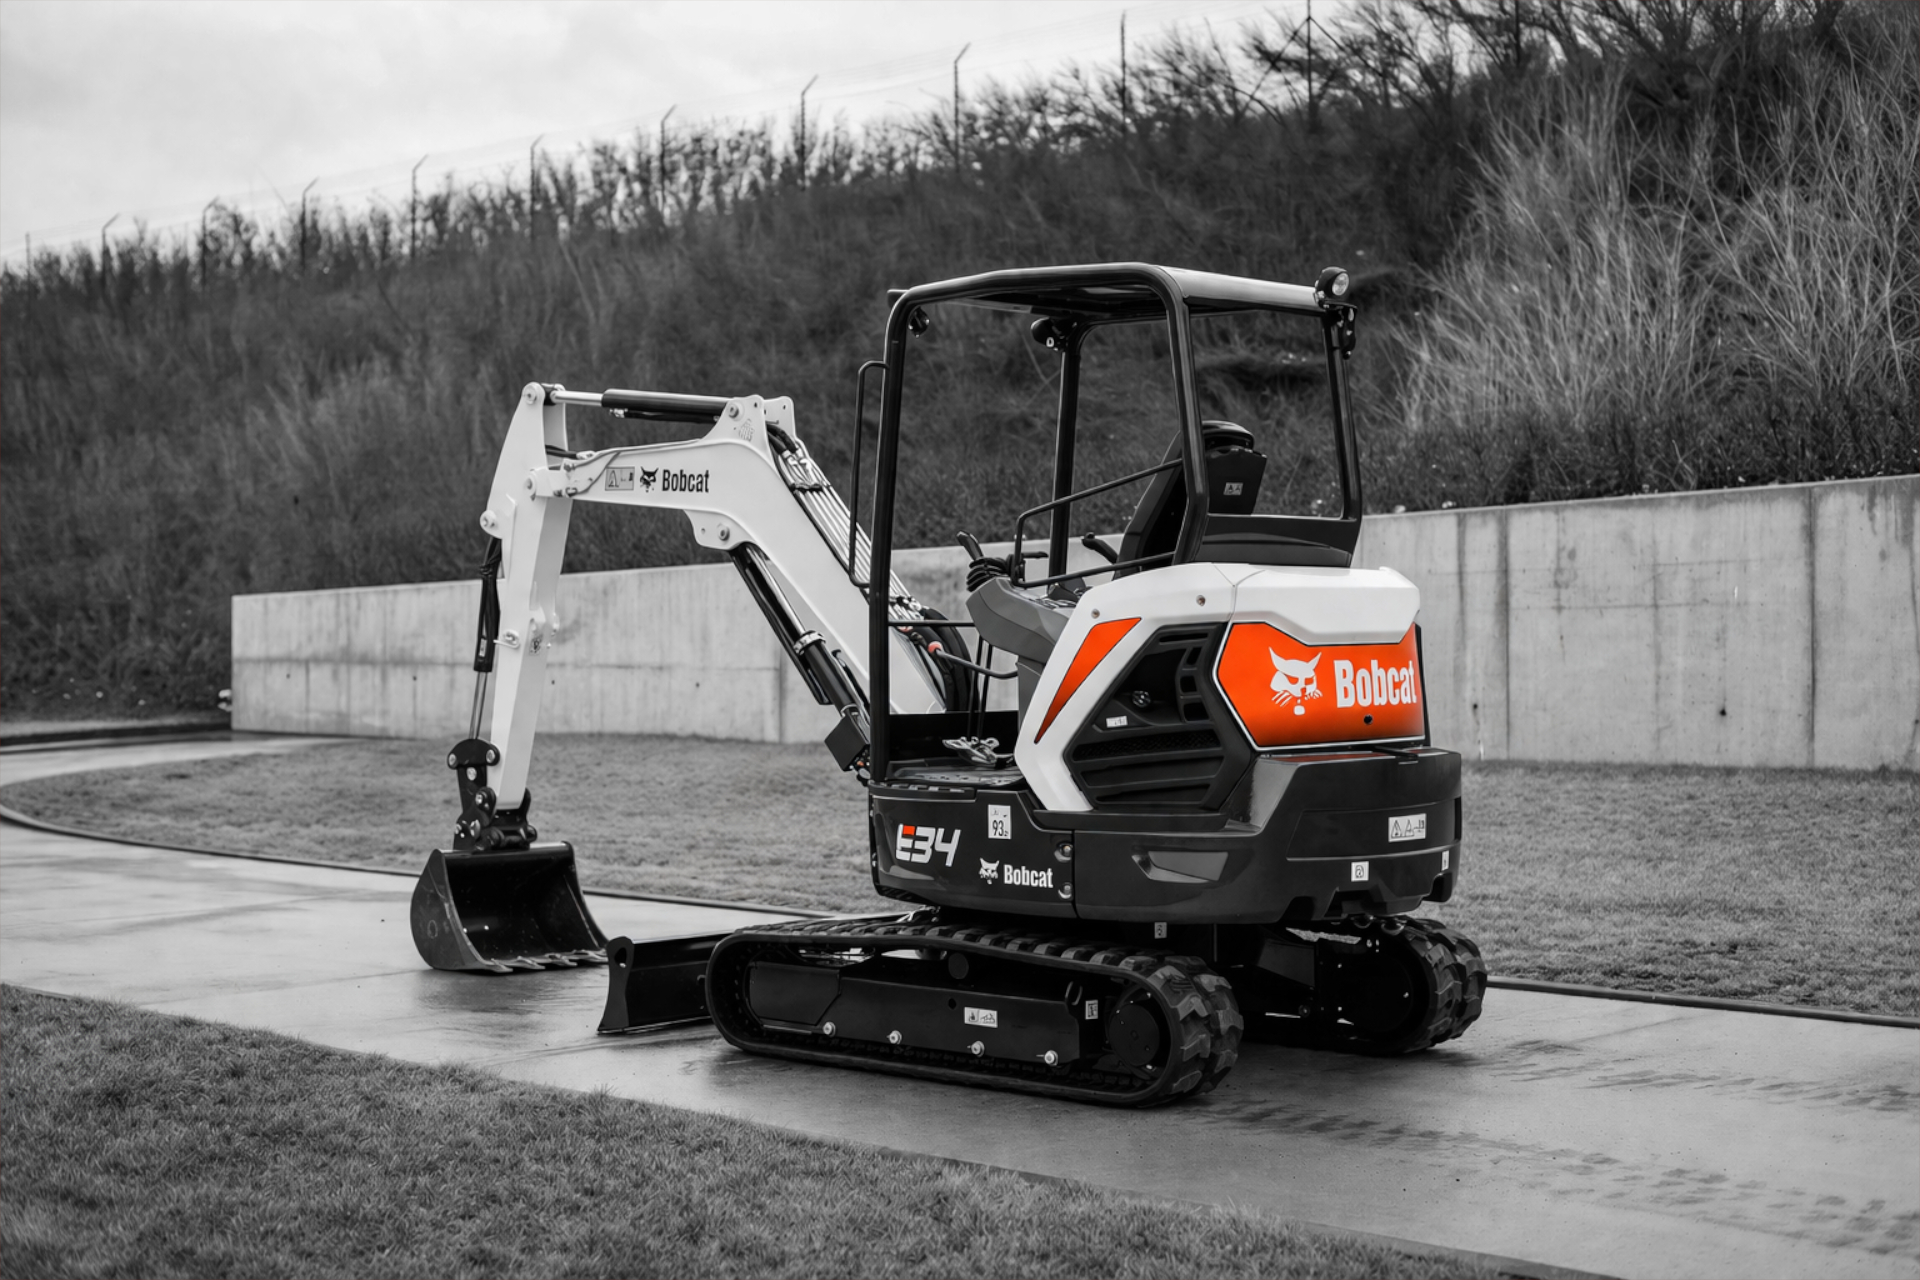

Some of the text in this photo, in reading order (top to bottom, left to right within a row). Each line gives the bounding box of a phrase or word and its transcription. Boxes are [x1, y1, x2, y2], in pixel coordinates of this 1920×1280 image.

[662, 469, 709, 492] Bobcat
[1333, 659, 1417, 708] Bobcat
[896, 823, 961, 867] E34
[1003, 864, 1053, 888] Bobcat
